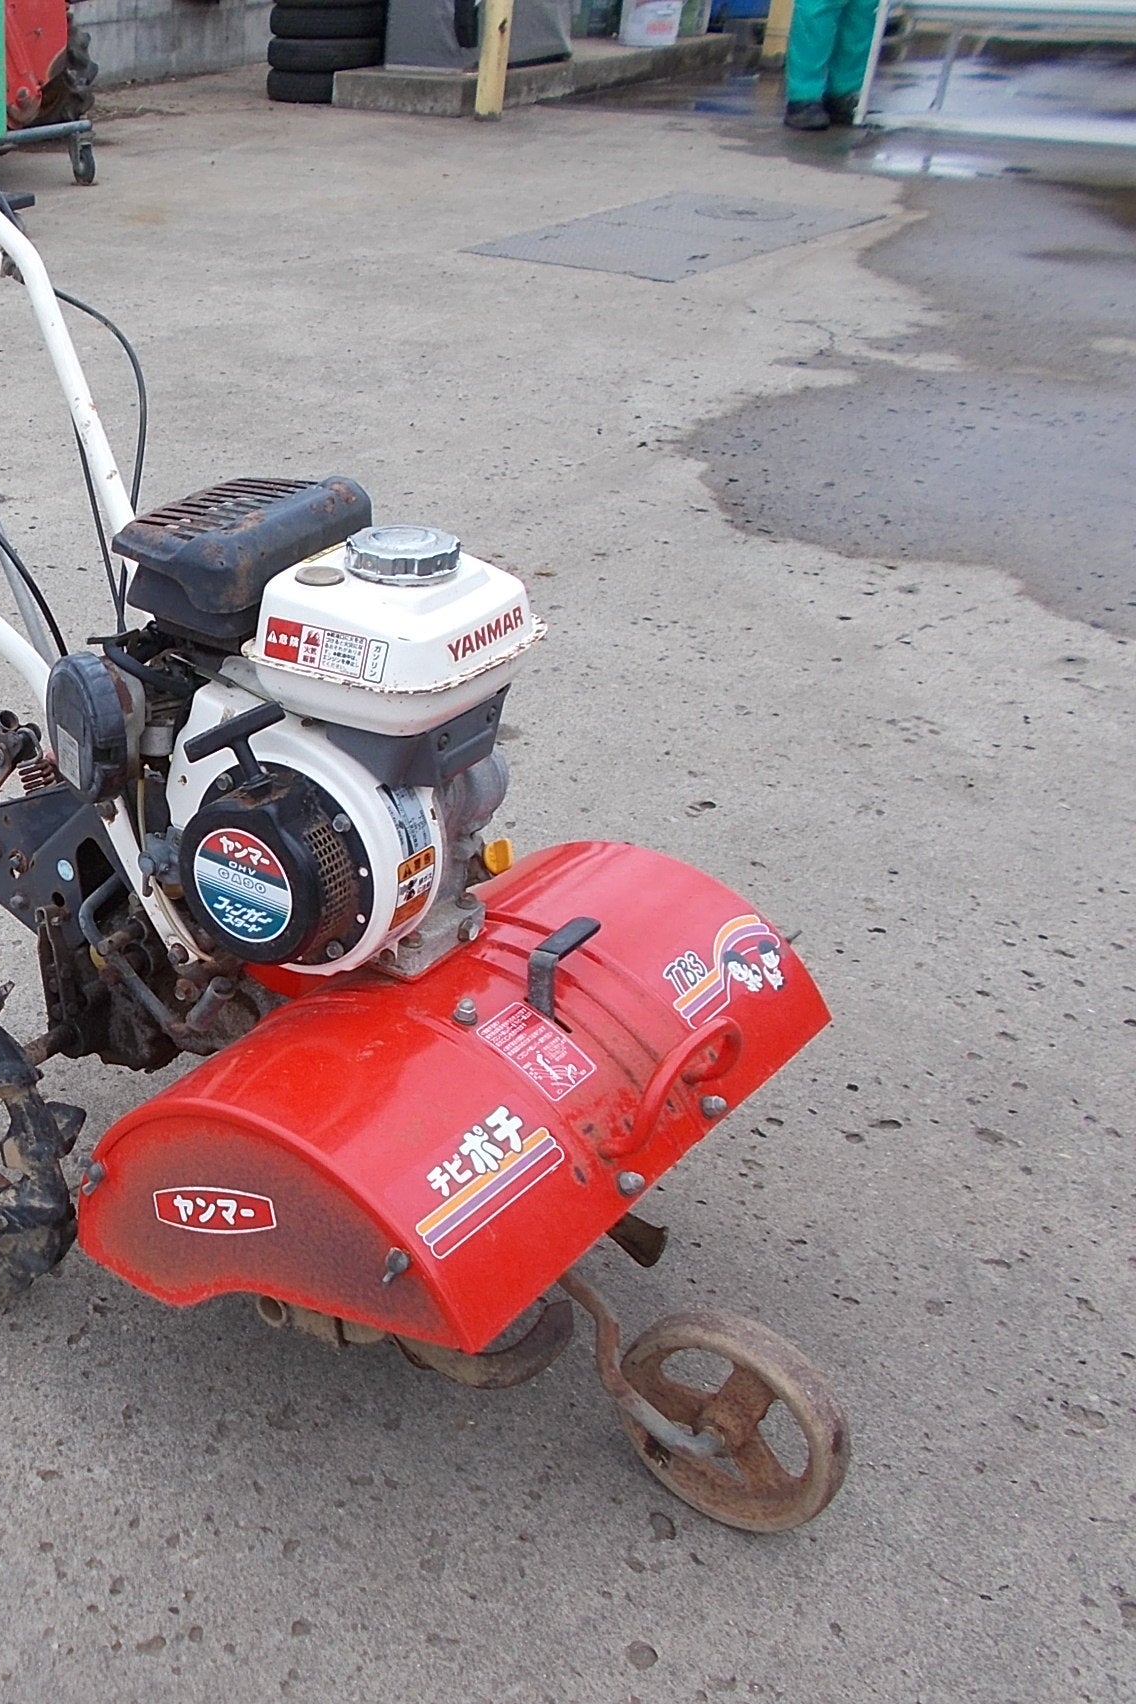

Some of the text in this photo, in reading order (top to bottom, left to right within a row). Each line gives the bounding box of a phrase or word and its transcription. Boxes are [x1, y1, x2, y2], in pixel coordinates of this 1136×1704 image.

[447, 605, 524, 662] YANMAR
[369, 646, 382, 677] ガソリン
[219, 835, 270, 865] ヤンマー
[228, 861, 257, 876] OHV
[425, 1105, 524, 1197] チビポチ
[173, 1194, 255, 1225] ヤンマー
